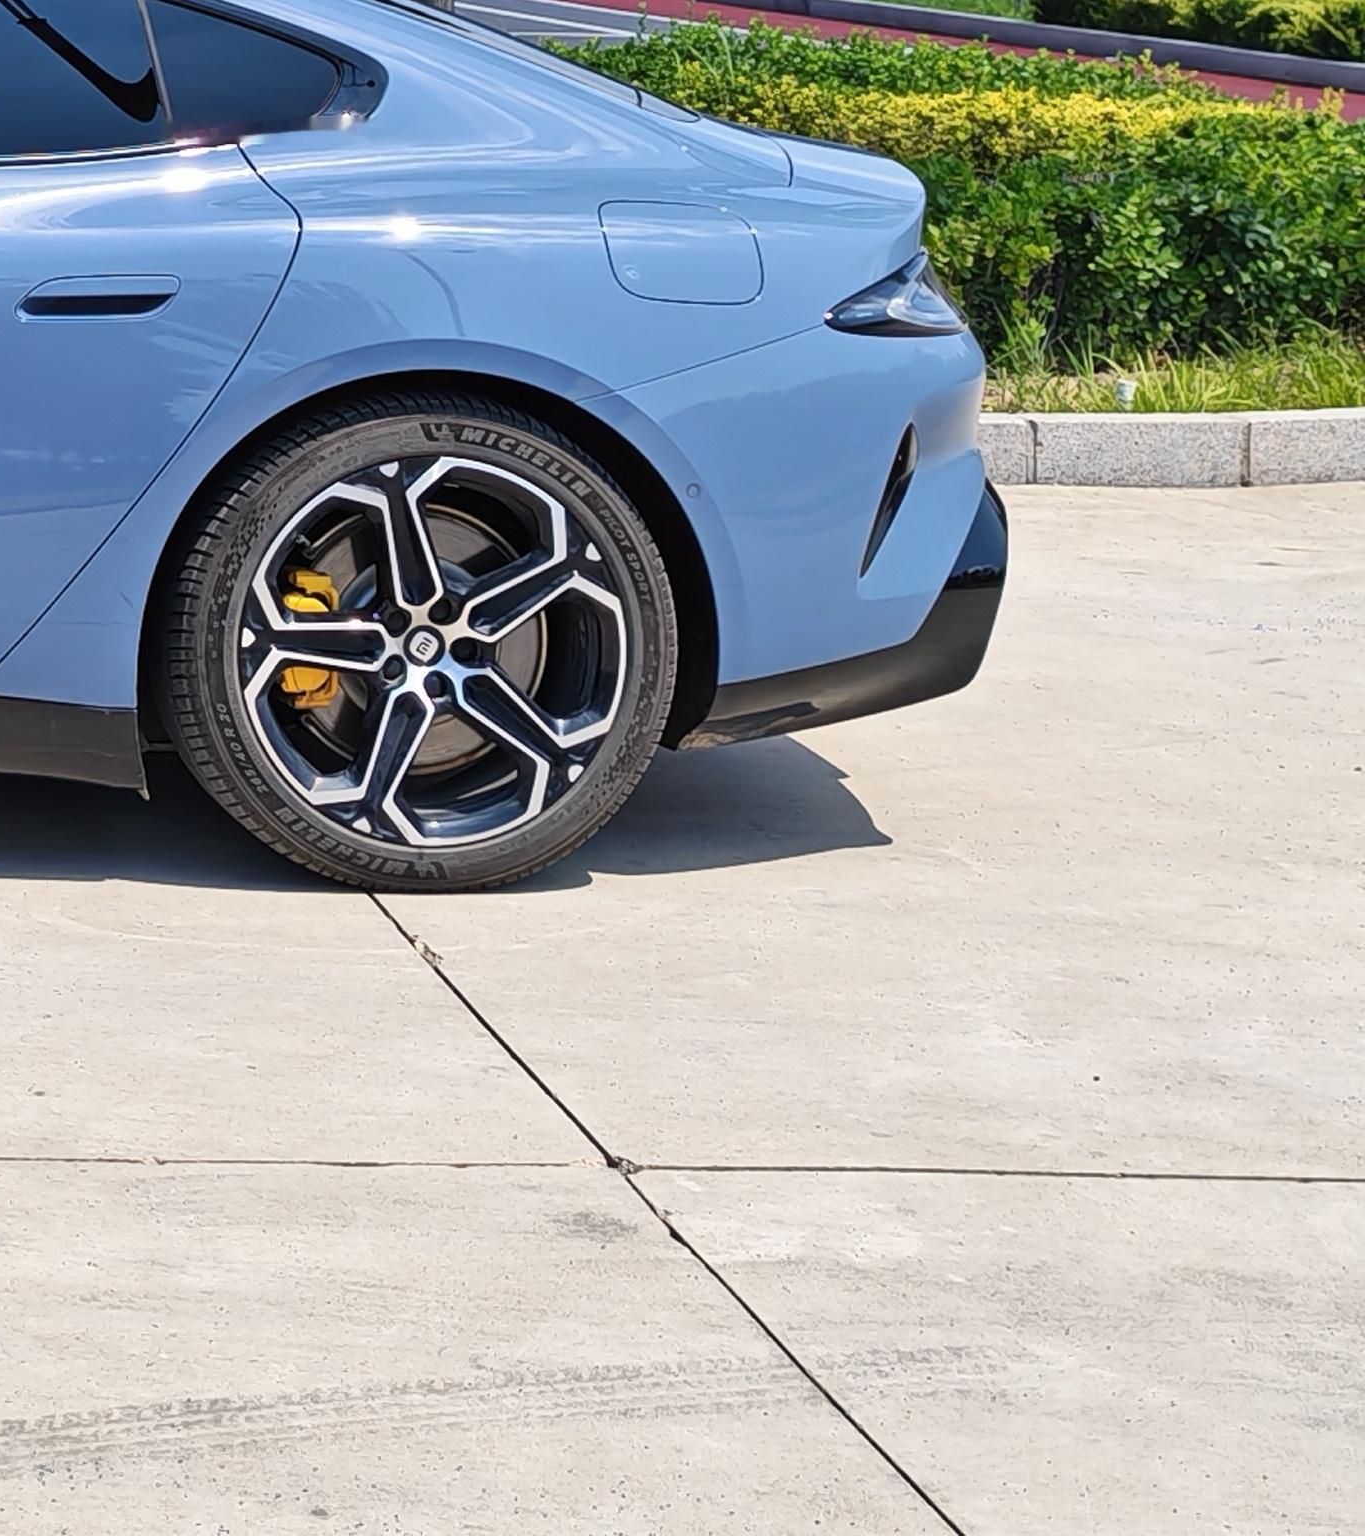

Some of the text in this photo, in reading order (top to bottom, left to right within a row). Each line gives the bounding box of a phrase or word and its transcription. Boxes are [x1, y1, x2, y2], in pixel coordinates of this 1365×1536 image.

[460, 427, 652, 602] MICHELIN PILOT SPORT
[216, 703, 231, 723] 20
[230, 742, 269, 793] 265/40
[273, 806, 410, 875] MICHELIN
